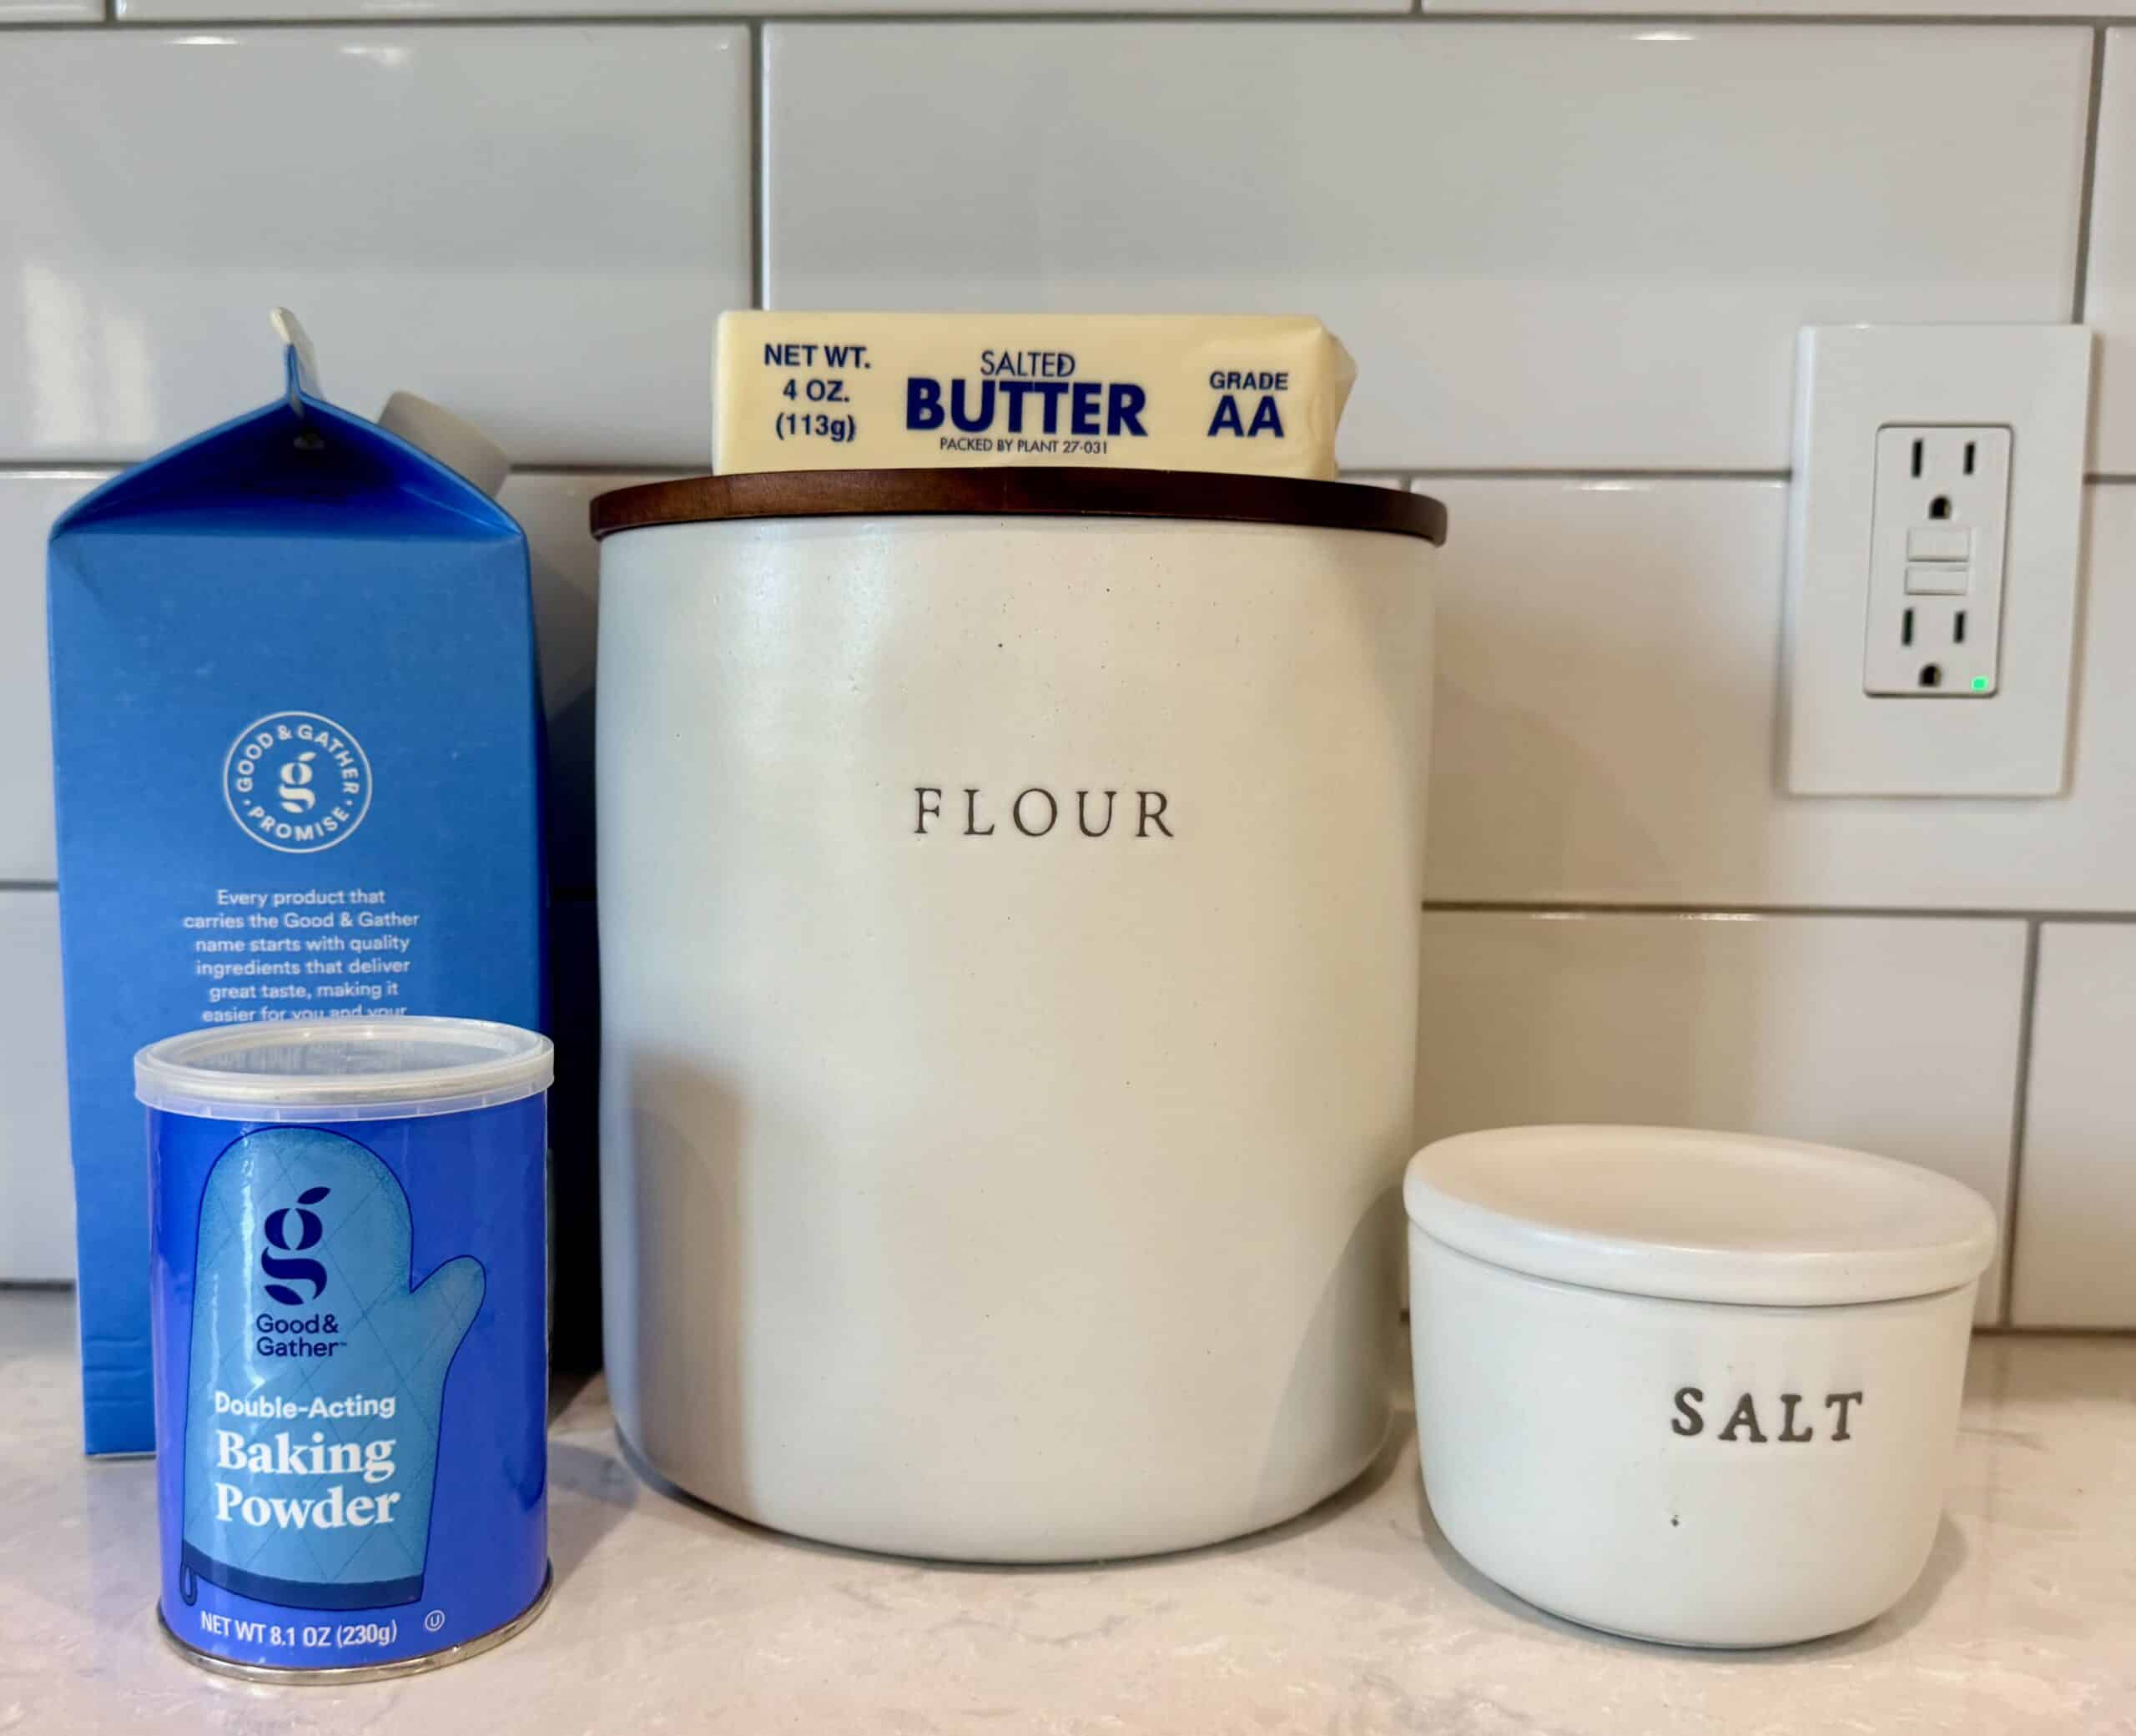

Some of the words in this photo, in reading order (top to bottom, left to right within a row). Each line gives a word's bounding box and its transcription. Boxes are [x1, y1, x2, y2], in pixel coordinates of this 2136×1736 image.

[764, 343, 819, 367] NET
[824, 345, 871, 369] WT.
[980, 350, 1076, 377] SALTED
[783, 378, 797, 400] 4
[806, 379, 850, 402] OZ.
[1209, 371, 1289, 390] GRADE
[905, 377, 1149, 436] BUTTER
[1207, 395, 1285, 438] AA
[775, 412, 857, 442] (113g)
[940, 437, 993, 452] PACKED
[997, 439, 1013, 452] BY
[1017, 440, 1059, 453] PLANT
[1063, 440, 1108, 455] 27-031
[236, 732, 274, 793] GOOD
[277, 725, 293, 741] &
[297, 724, 360, 794] GATHER
[248, 806, 350, 841] PROMISE
[914, 787, 1175, 838] FLOUR
[217, 889, 269, 908] Every
[274, 889, 345, 908] product
[350, 888, 385, 904] that
[184, 913, 244, 928] carries
[249, 913, 279, 928] the
[284, 913, 335, 928] Good
[340, 912, 354, 928] &
[359, 911, 420, 927] Gather
[195, 939, 245, 952] name
[250, 938, 301, 952] starts
[306, 935, 345, 951] with
[350, 934, 411, 954] quality
[196, 960, 301, 980] ingredients
[306, 959, 343, 974] that
[349, 957, 411, 974] deliver
[209, 985, 257, 1003] great
[262, 985, 312, 1000] taste,
[317, 981, 382, 999] making
[387, 980, 400, 995] it
[201, 1006, 256, 1022] easier
[261, 1006, 287, 1021] for
[292, 1010, 324, 1020] you
[329, 1003, 363, 1018] and
[214, 1390, 396, 1418] Double-Acting
[1670, 1386, 1863, 1443] SALT
[215, 1428, 397, 1484] Baking
[214, 1481, 401, 1530] Powder
[200, 1610, 232, 1637] NET
[234, 1622, 268, 1643] WT
[270, 1627, 295, 1647] 8.1
[303, 1627, 332, 1647] OZ
[336, 1619, 398, 1648] (230g)
